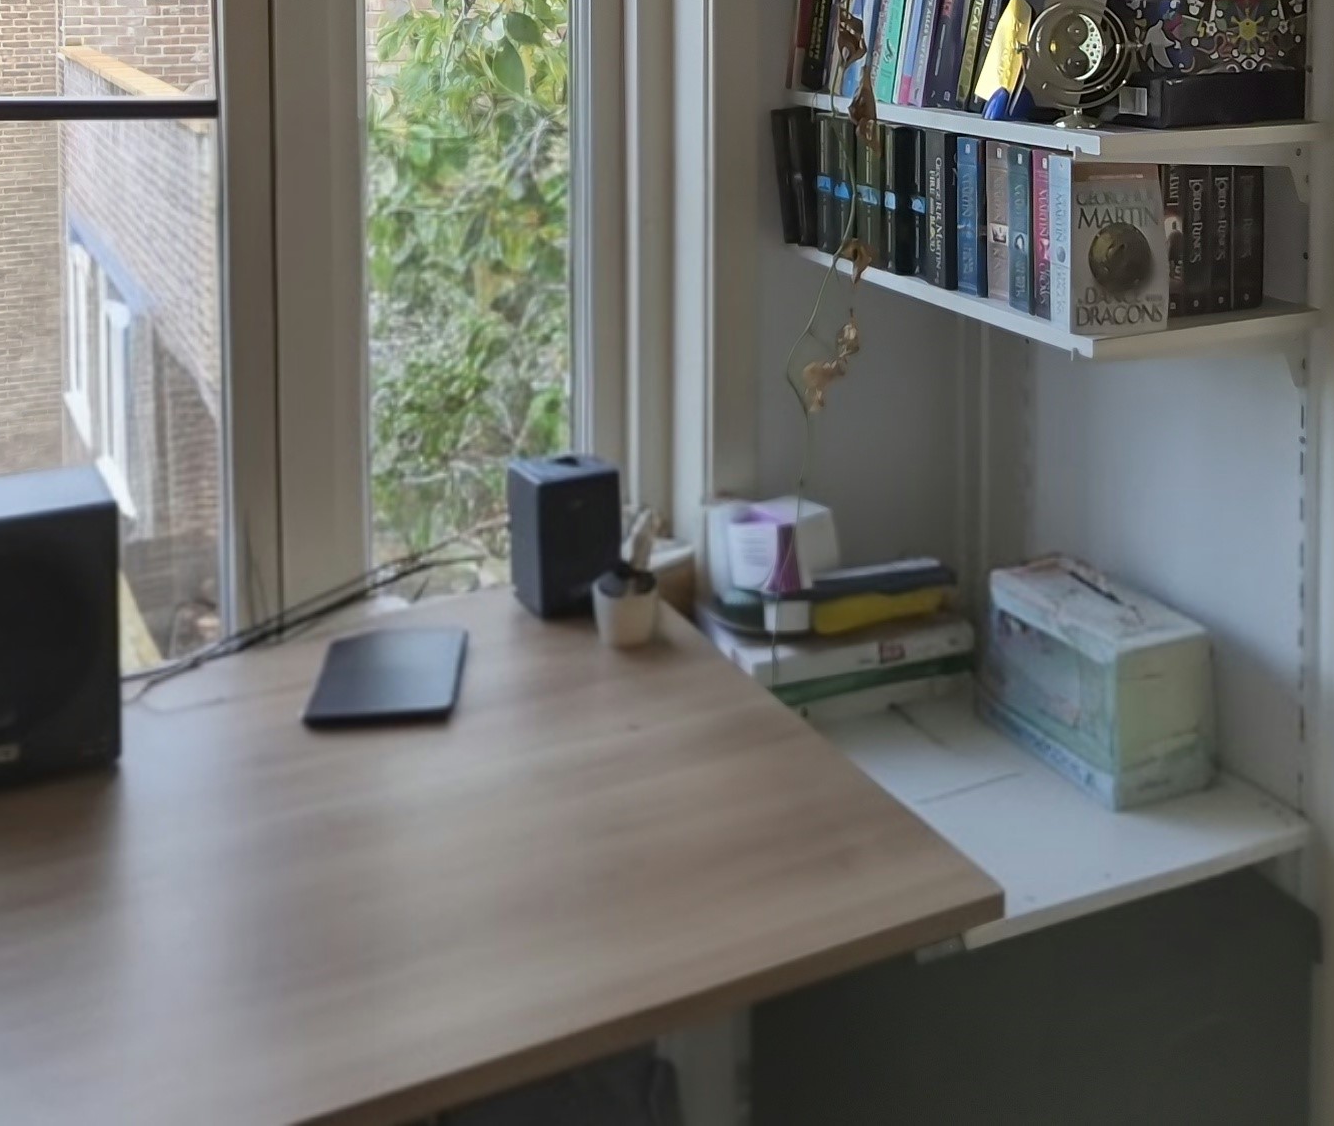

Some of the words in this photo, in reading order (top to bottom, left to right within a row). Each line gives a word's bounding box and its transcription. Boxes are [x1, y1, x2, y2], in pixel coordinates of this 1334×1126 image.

[1078, 207, 1159, 229] MARTIN
[935, 224, 943, 270] MARTIN
[1076, 304, 1163, 326] DRAGONS
